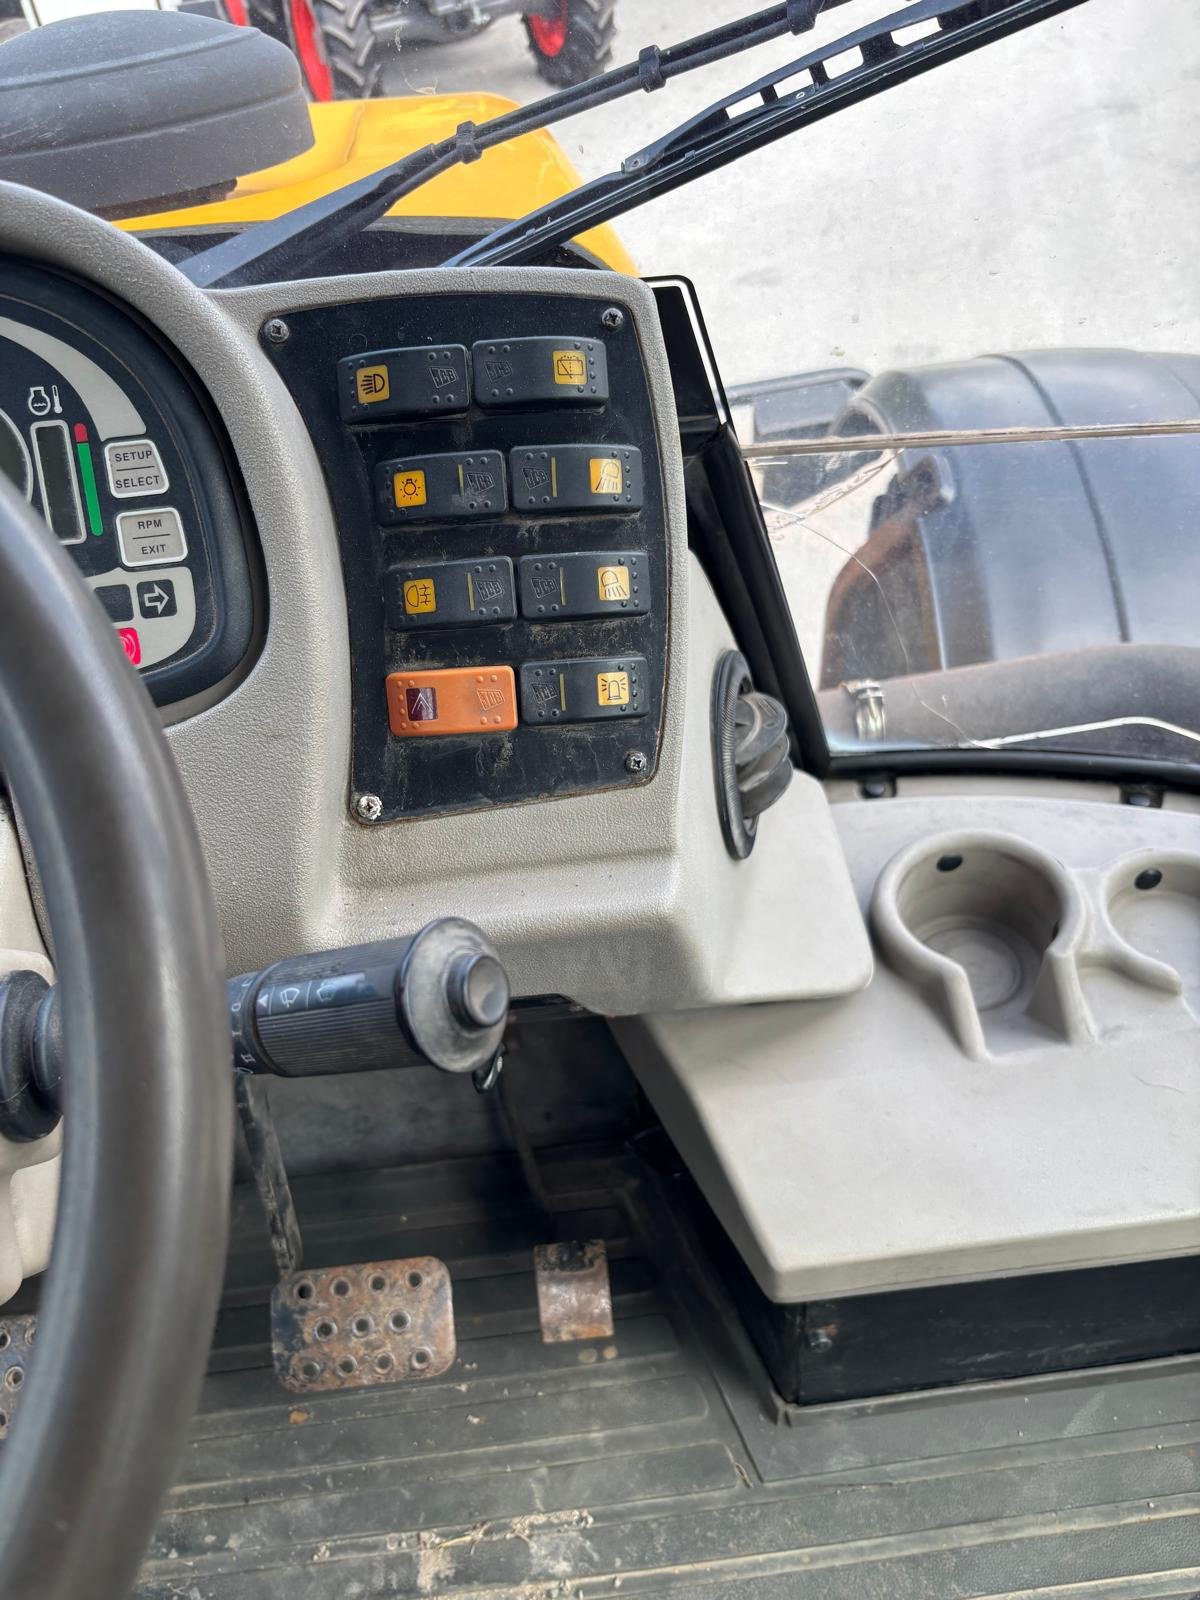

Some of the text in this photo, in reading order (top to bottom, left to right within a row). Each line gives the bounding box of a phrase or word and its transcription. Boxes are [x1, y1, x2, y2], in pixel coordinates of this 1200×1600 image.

[430, 367, 457, 388] JCB
[485, 361, 512, 382] JCB
[115, 450, 153, 462] SETUP
[116, 475, 160, 489] SELECT
[523, 468, 549, 488] JCB
[137, 519, 162, 530] RPM
[141, 544, 166, 555] EXIT
[476, 580, 503, 600] JCB
[532, 578, 558, 598] JCB
